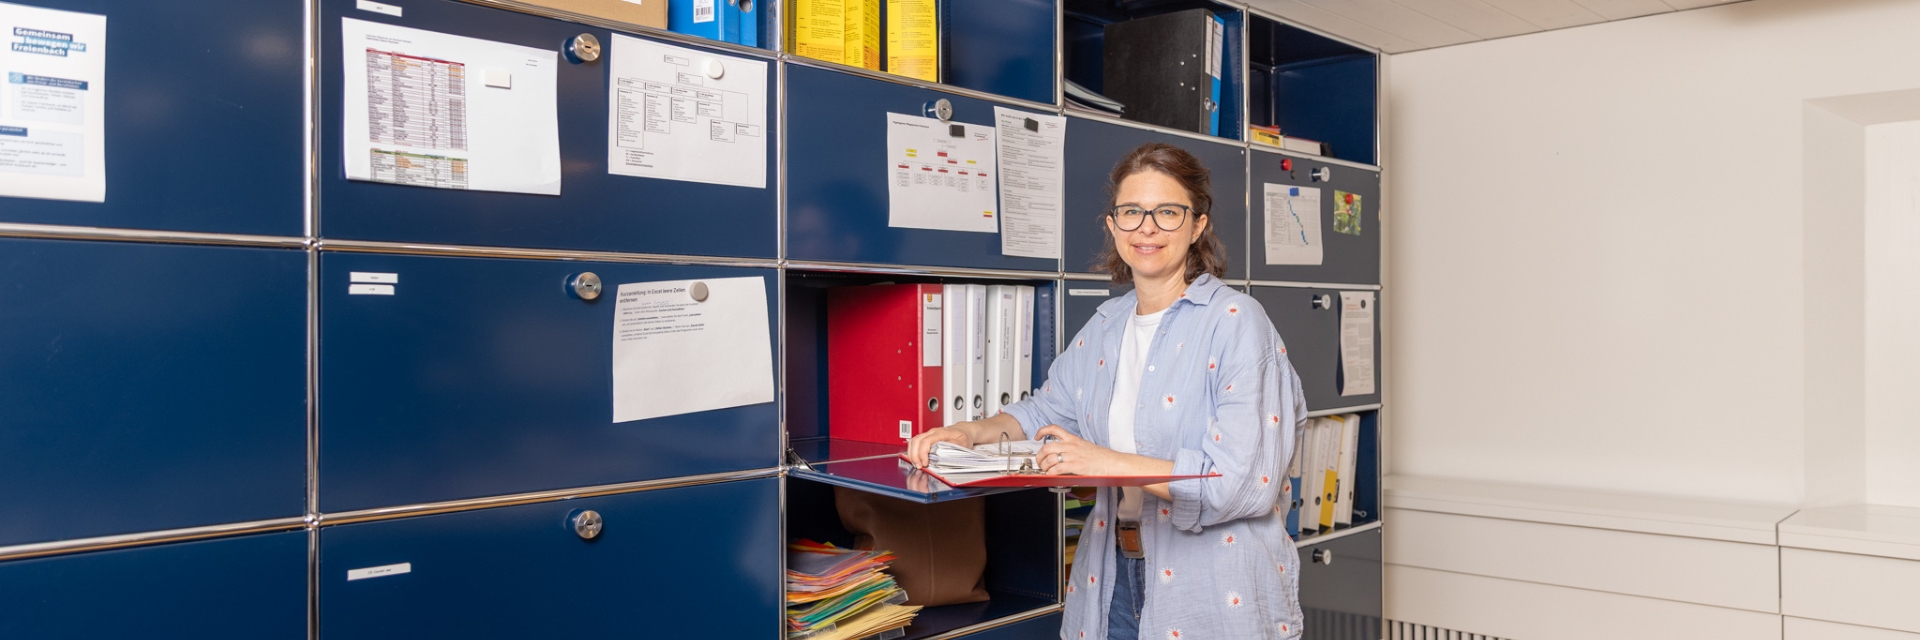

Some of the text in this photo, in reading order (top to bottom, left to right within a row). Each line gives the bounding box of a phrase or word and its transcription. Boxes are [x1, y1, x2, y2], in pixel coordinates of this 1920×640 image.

[15, 28, 71, 41] Gemeinsam
[13, 43, 66, 56] Freienbach
[25, 37, 85, 51] bewegen wir
